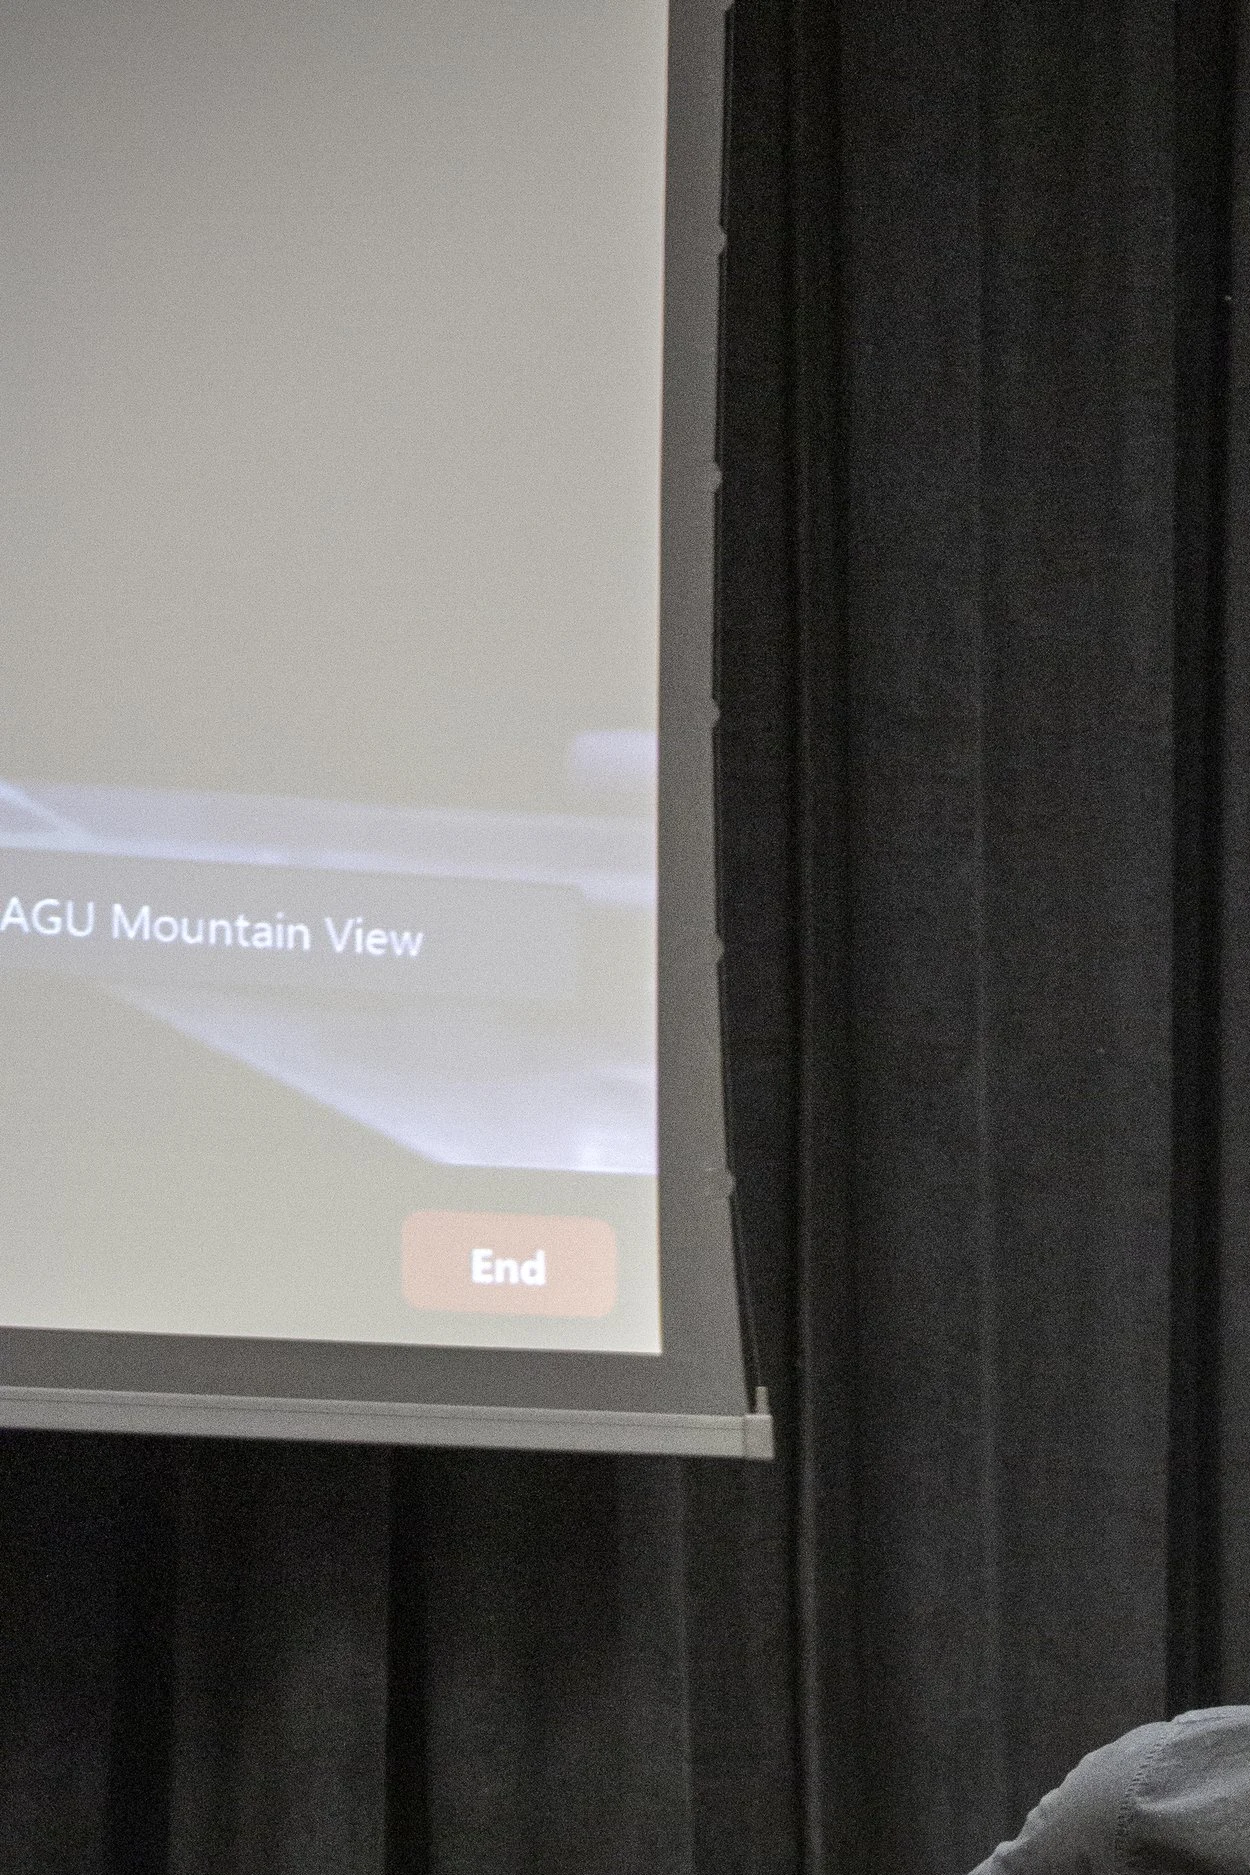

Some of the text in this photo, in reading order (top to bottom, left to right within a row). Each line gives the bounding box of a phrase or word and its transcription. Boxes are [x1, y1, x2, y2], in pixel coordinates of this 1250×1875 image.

[0, 896, 424, 957] AGU Mountain View
[470, 1248, 547, 1286] End
